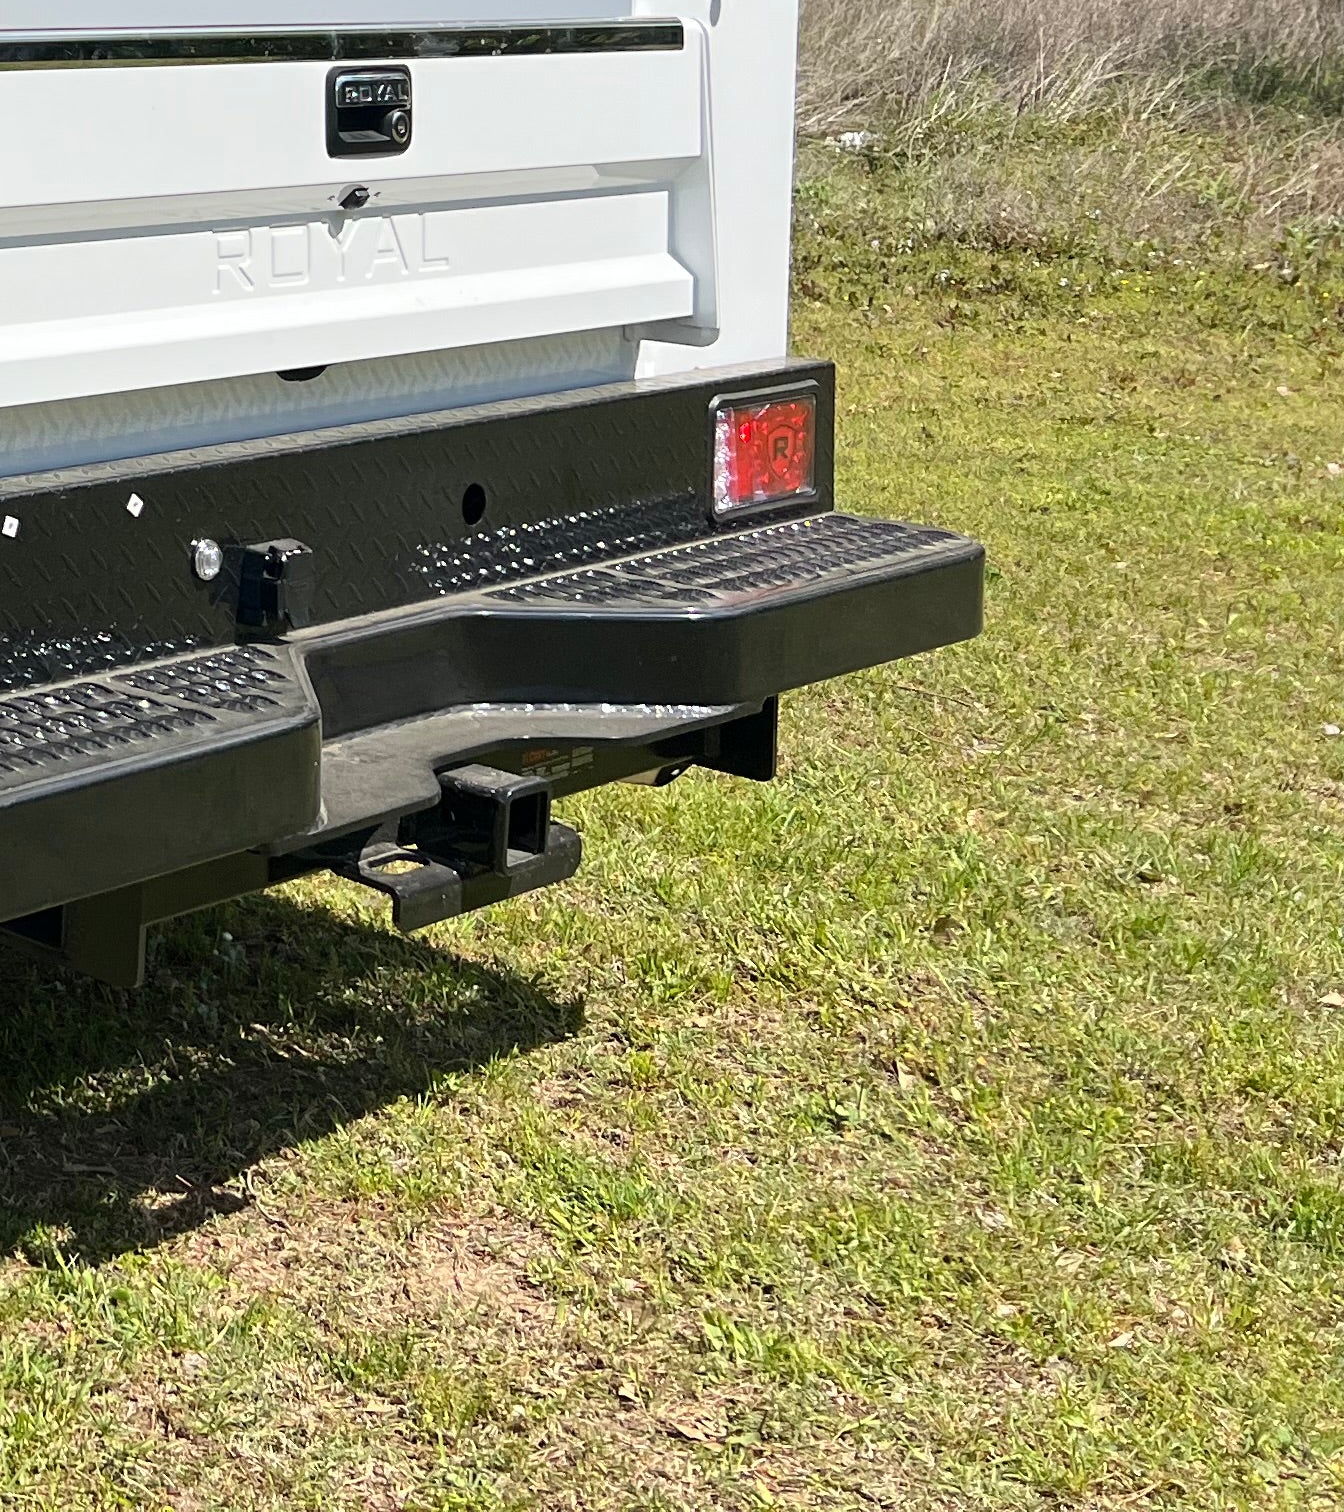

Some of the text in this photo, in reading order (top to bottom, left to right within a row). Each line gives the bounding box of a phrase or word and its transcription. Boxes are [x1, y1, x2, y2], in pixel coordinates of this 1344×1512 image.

[345, 83, 409, 103] ROYAL
[211, 210, 451, 294] ROYAL
[774, 436, 789, 461] R
